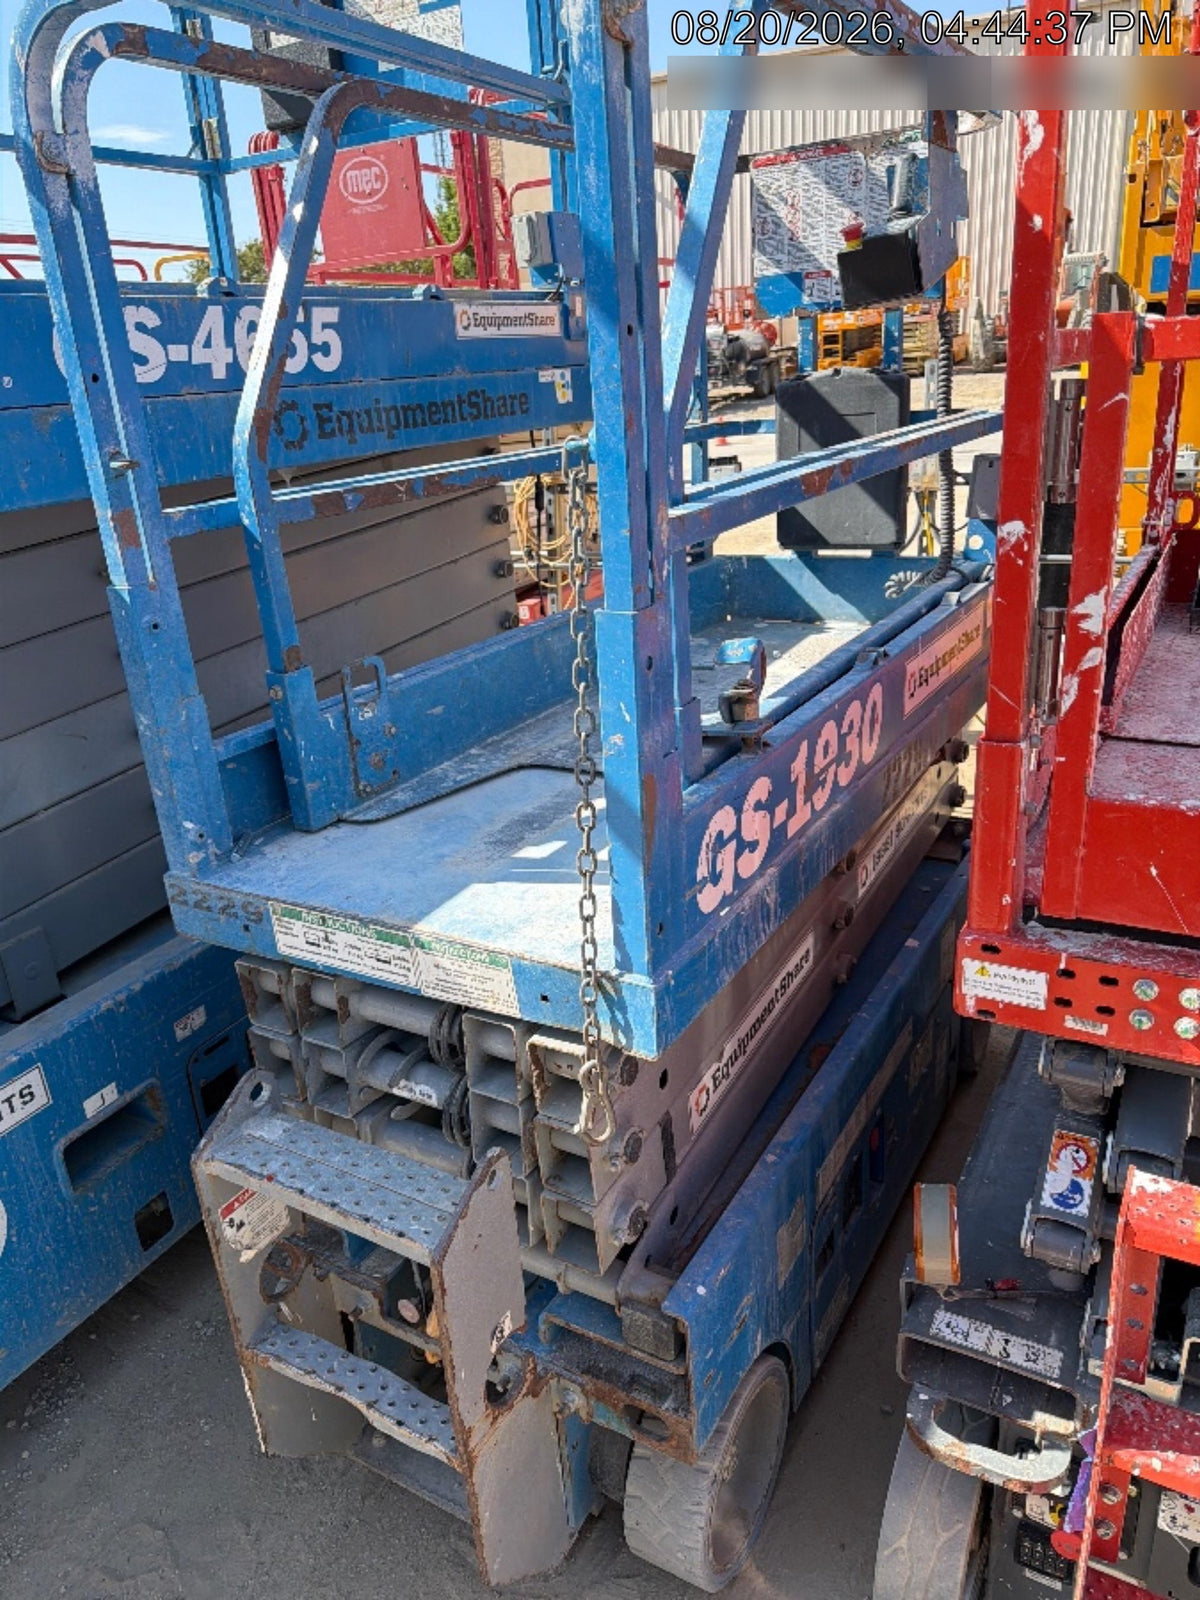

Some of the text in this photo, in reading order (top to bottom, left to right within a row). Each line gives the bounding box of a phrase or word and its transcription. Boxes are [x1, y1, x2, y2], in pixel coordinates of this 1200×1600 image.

[472, 311, 556, 331] EquipmentShare
[312, 389, 530, 445] EquipmentShare
[916, 624, 981, 690] EquipmentShare
[696, 682, 883, 914] GS-1930
[711, 947, 811, 1095] EquipmentShare
[0, 1084, 36, 1122] TS
